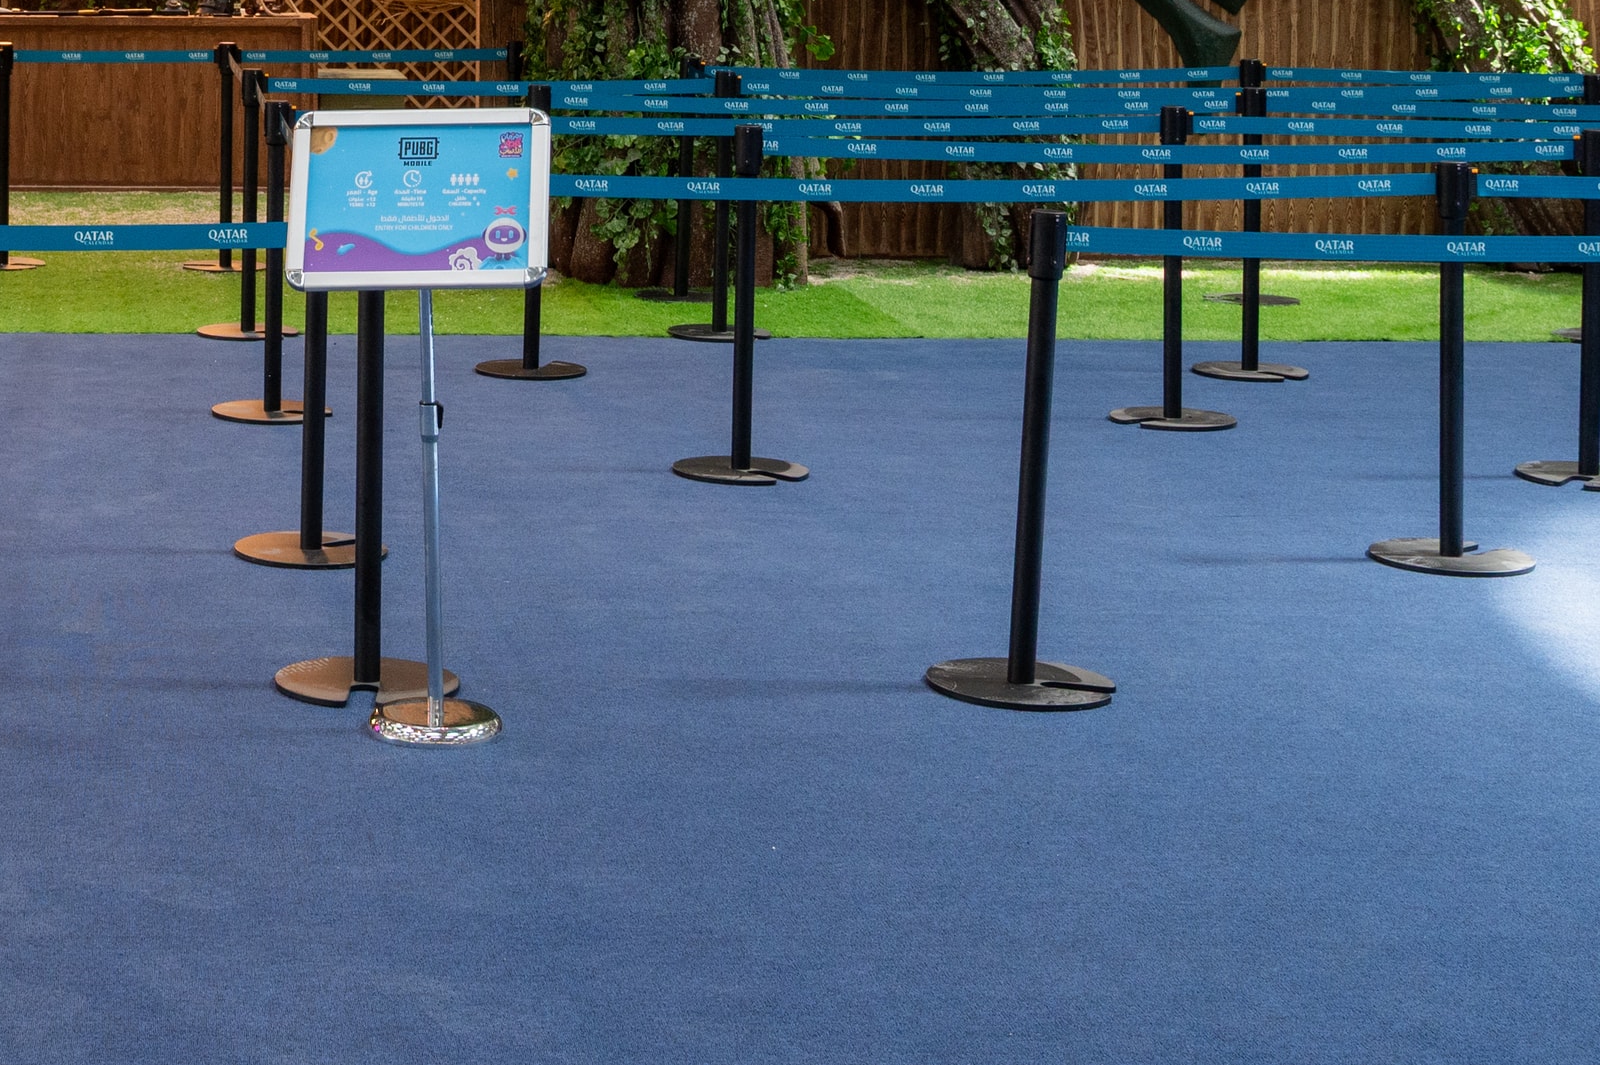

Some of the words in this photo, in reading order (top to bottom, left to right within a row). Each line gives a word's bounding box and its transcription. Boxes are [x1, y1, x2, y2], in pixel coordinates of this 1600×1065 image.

[496, 84, 519, 92] QATAR
[1415, 88, 1438, 96] QATAR
[1118, 90, 1141, 98] QATAR
[564, 96, 588, 105] QATAR
[644, 99, 668, 107] QATAR
[724, 101, 749, 109] QATAR
[1204, 100, 1228, 108] QATAR
[1311, 101, 1336, 109] QATAR
[804, 102, 829, 111] QATAR
[884, 103, 909, 111] QATAR
[1124, 102, 1148, 110] QATAR
[1391, 104, 1416, 112] QATAR
[1552, 108, 1577, 116] QATAR
[569, 120, 596, 129] QATAR
[657, 121, 684, 130] QATAR
[834, 122, 862, 131] QATAR
[923, 122, 951, 131] QATAR
[1012, 121, 1040, 130] QATAR
[1101, 119, 1129, 128] QATAR
[1199, 120, 1226, 128] QATAR
[1287, 121, 1314, 130] QATAR
[1376, 123, 1403, 132] QATAR
[1464, 125, 1492, 134] QATAR
[1553, 126, 1580, 134] QATAR
[404, 141, 433, 155] PUBG
[762, 140, 779, 150] TAR
[847, 143, 877, 152] QATAR
[945, 146, 975, 155] QATAR
[1043, 147, 1073, 157] QATAR
[1141, 149, 1171, 158] QATAR
[1240, 149, 1269, 158] QATAR
[1338, 148, 1368, 158] QATAR
[1436, 147, 1466, 157] QATAR
[1534, 145, 1565, 155] QATAR
[575, 179, 608, 189] QATAR
[686, 181, 720, 191] QATAR
[798, 183, 832, 193] QATAR
[1246, 182, 1279, 192] QATAR
[1357, 179, 1391, 190] QATAR
[1485, 179, 1519, 189] QATAR
[910, 184, 944, 194] QATAR
[1022, 184, 1056, 194] QATAR
[1134, 184, 1168, 194] QATAR
[74, 230, 114, 243] QATAR
[208, 228, 248, 241] QATAR
[1066, 231, 1090, 243] TAR
[1183, 236, 1222, 248] QATAR
[1315, 239, 1354, 251] QATAR
[1446, 241, 1486, 253] QATAR
[1578, 242, 1600, 254] QAT
